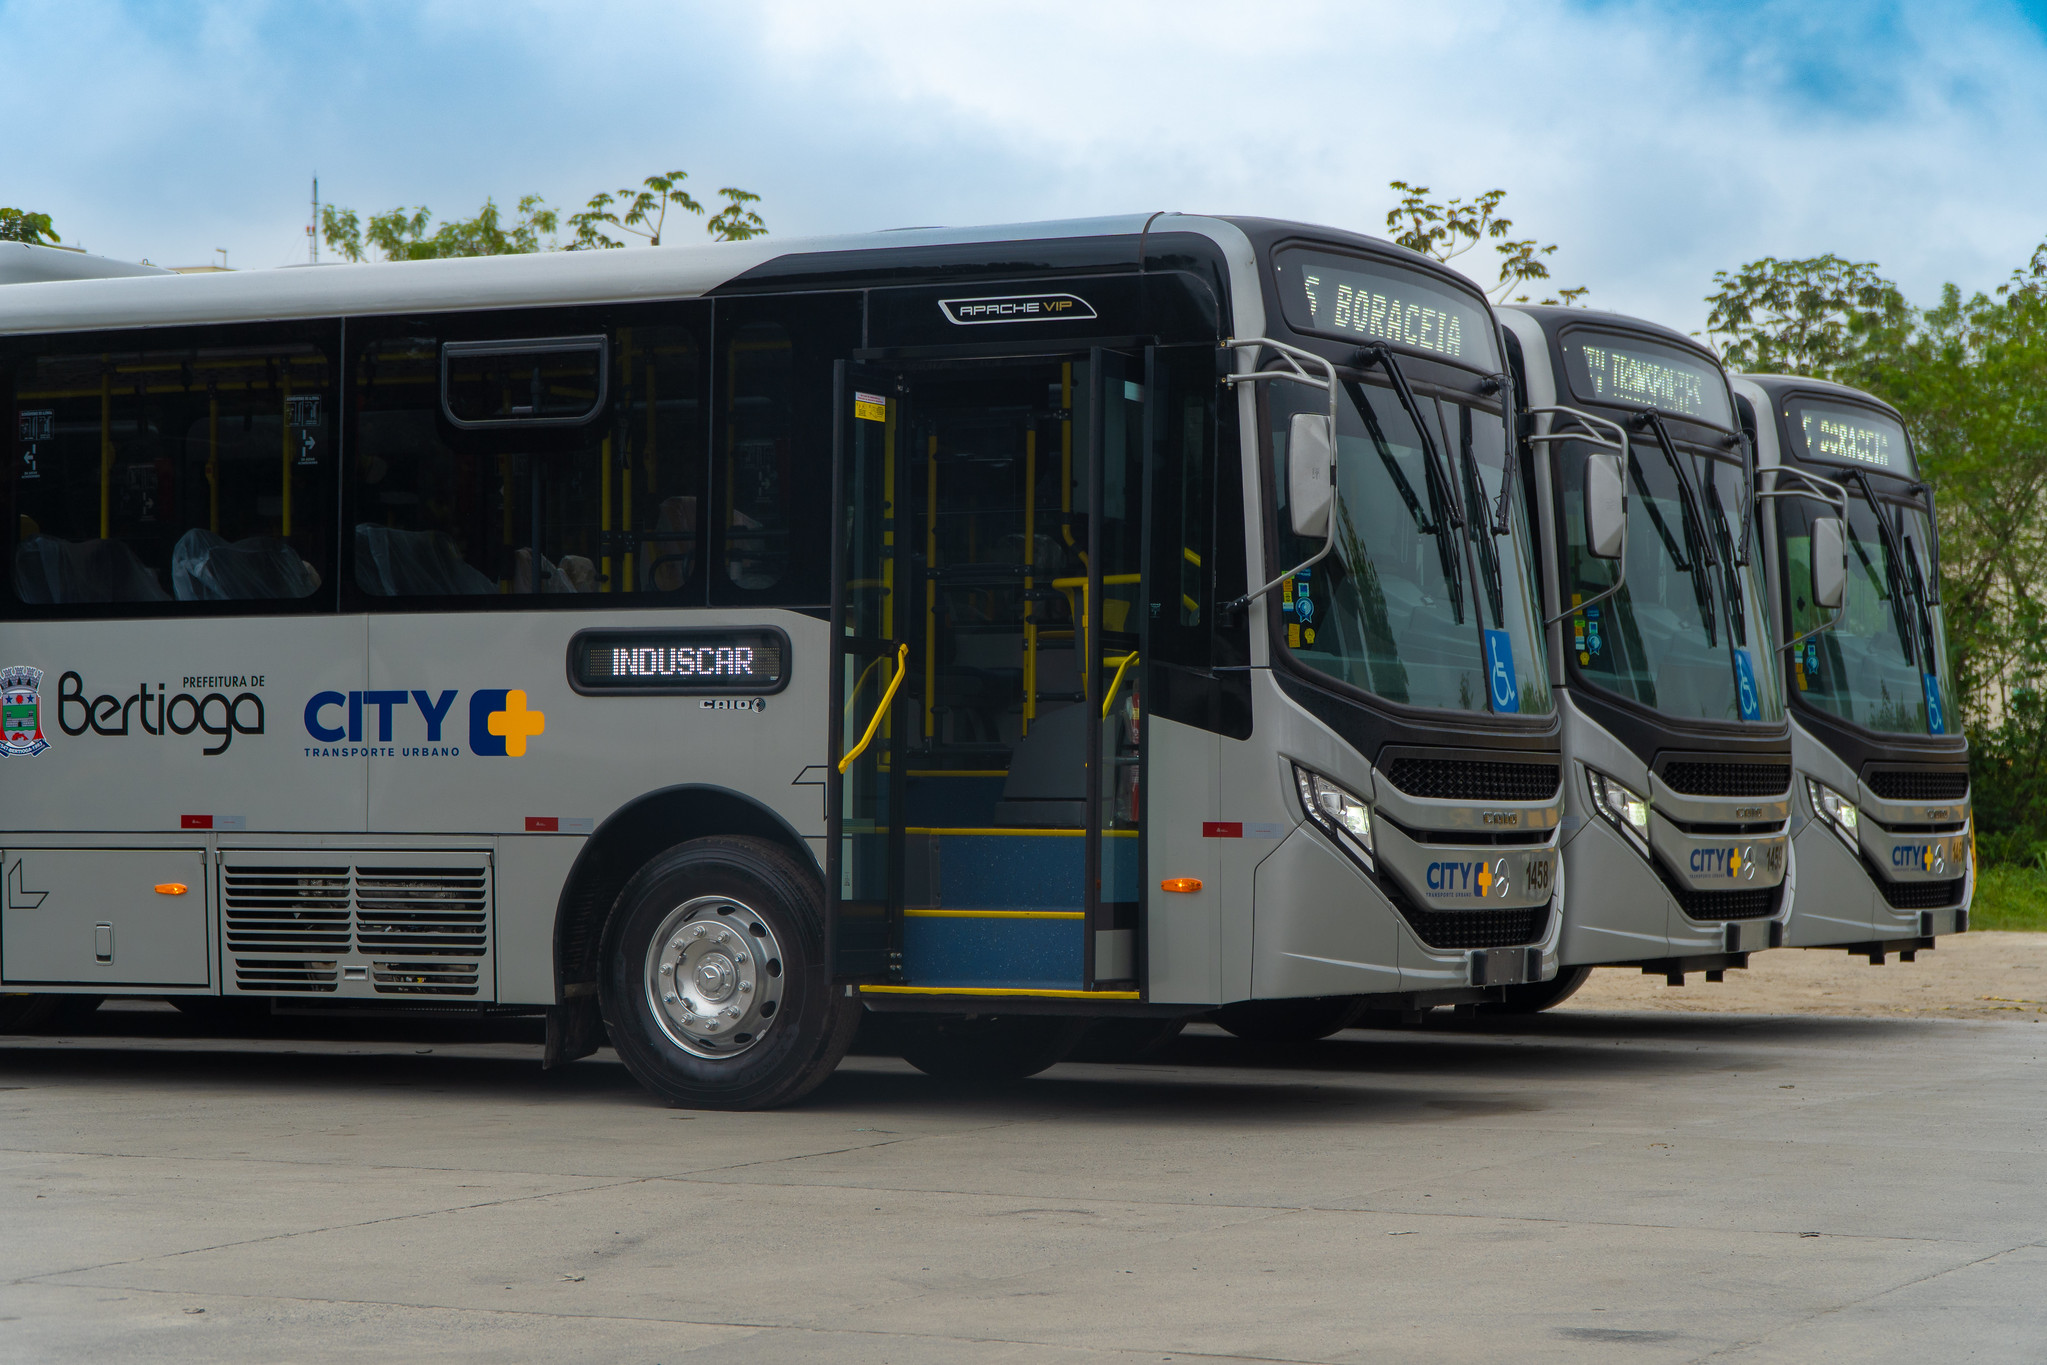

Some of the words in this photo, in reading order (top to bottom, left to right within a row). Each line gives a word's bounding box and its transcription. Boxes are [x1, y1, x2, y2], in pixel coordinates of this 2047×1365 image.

[960, 302, 1040, 316] APACHE
[1043, 301, 1073, 312] VIP
[1335, 284, 1461, 357] BORACEIA
[612, 647, 753, 675] INDUSCAR
[183, 676, 243, 688] PREFEITURA
[250, 675, 265, 687] DE
[57, 670, 265, 756] Bertioga
[304, 689, 459, 742] CITY
[700, 699, 751, 710] CAIO
[304, 748, 395, 757] TRANSPORTE
[402, 747, 460, 757] URBANO
[1690, 848, 1725, 871] CITY
[1892, 846, 1920, 865] CITY
[1426, 861, 1472, 890] CITY
[1526, 860, 1549, 891] 1458
